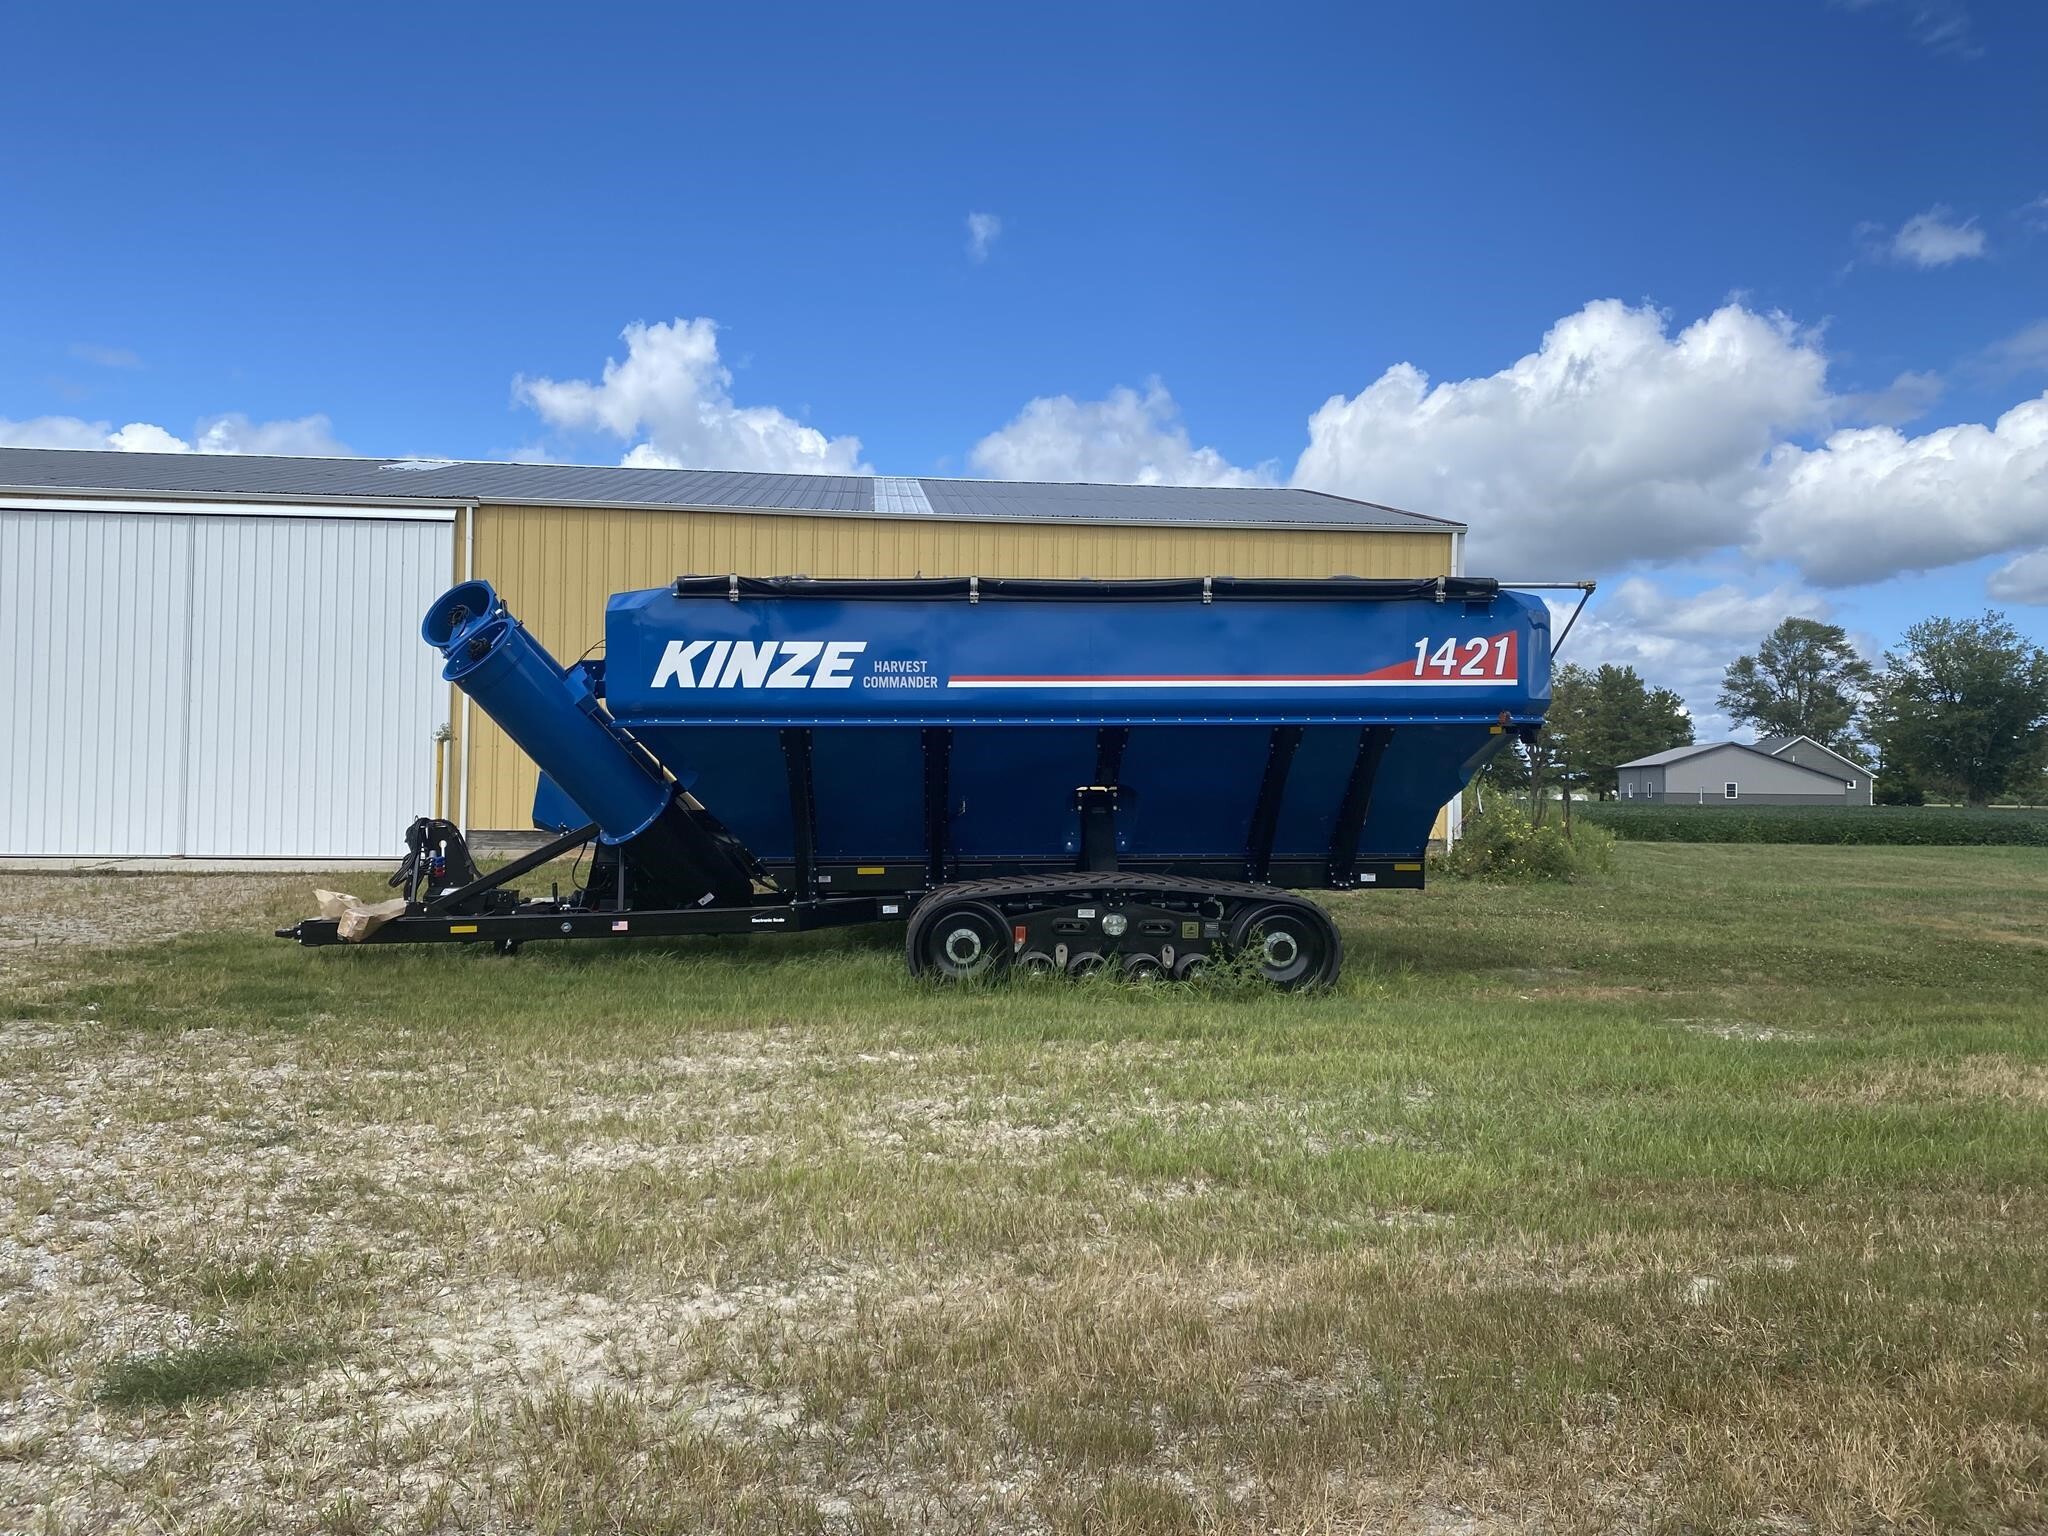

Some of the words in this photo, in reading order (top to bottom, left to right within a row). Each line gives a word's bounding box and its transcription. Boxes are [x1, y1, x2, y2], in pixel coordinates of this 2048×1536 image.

[650, 640, 868, 689] KINZE
[874, 660, 928, 673] HARVEST
[1414, 636, 1509, 676] 1421
[862, 675, 939, 689] COMMANDER
